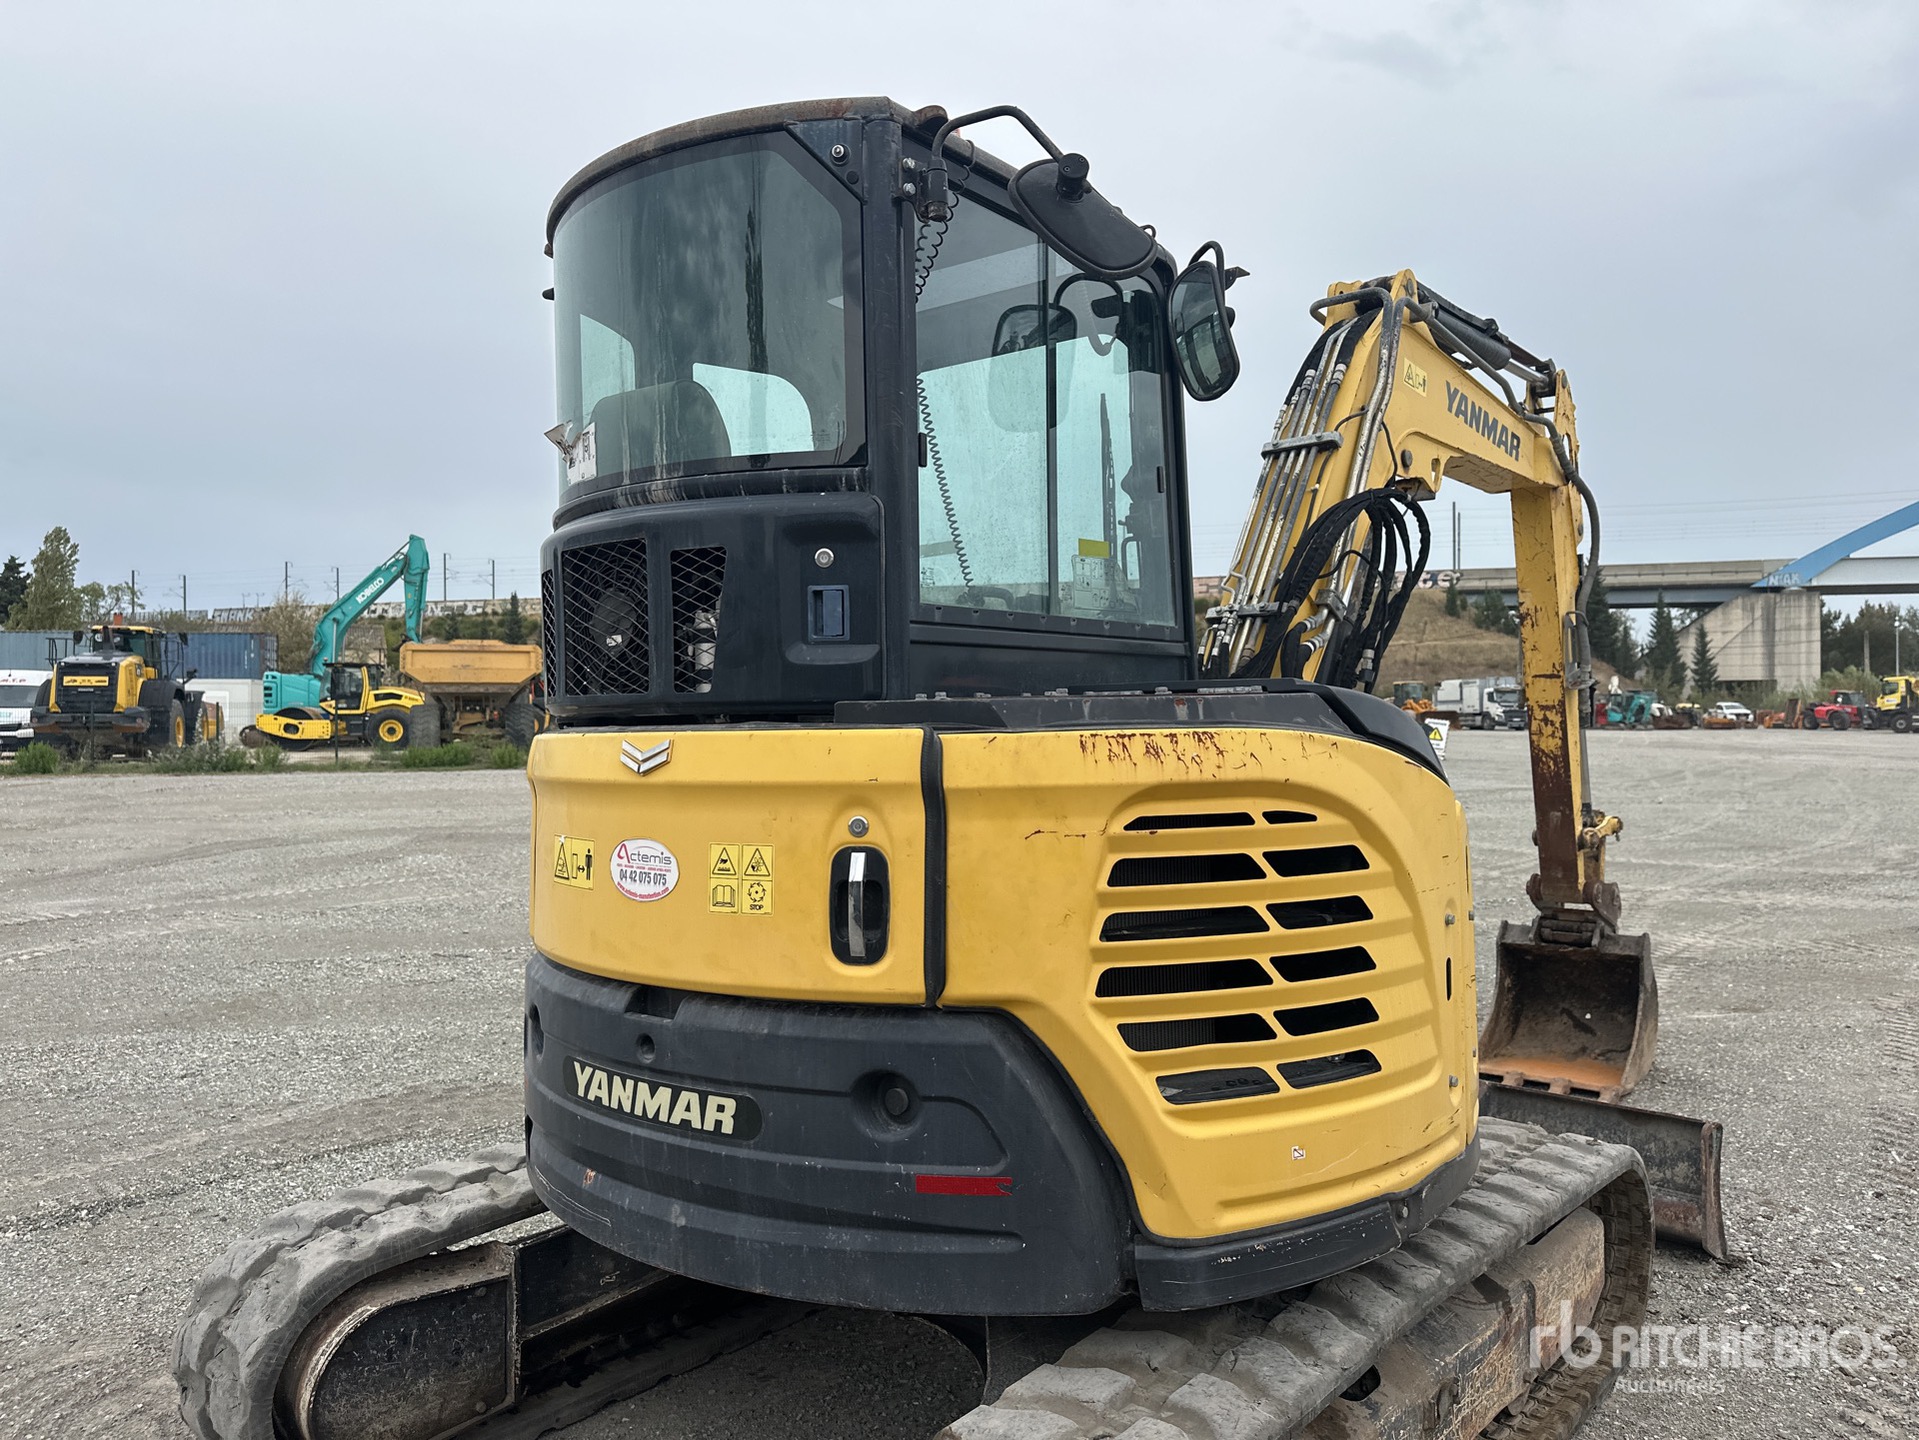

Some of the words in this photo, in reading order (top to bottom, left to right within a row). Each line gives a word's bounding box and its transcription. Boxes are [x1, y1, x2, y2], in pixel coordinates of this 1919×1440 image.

[1445, 380, 1521, 462] YANMAR
[617, 843, 672, 865] Actemis
[619, 868, 628, 881] 04
[629, 870, 637, 883] 42
[638, 871, 652, 884] 075
[653, 872, 667, 887] 075
[749, 903, 764, 911] STOP
[573, 1061, 737, 1135] YANMAR
